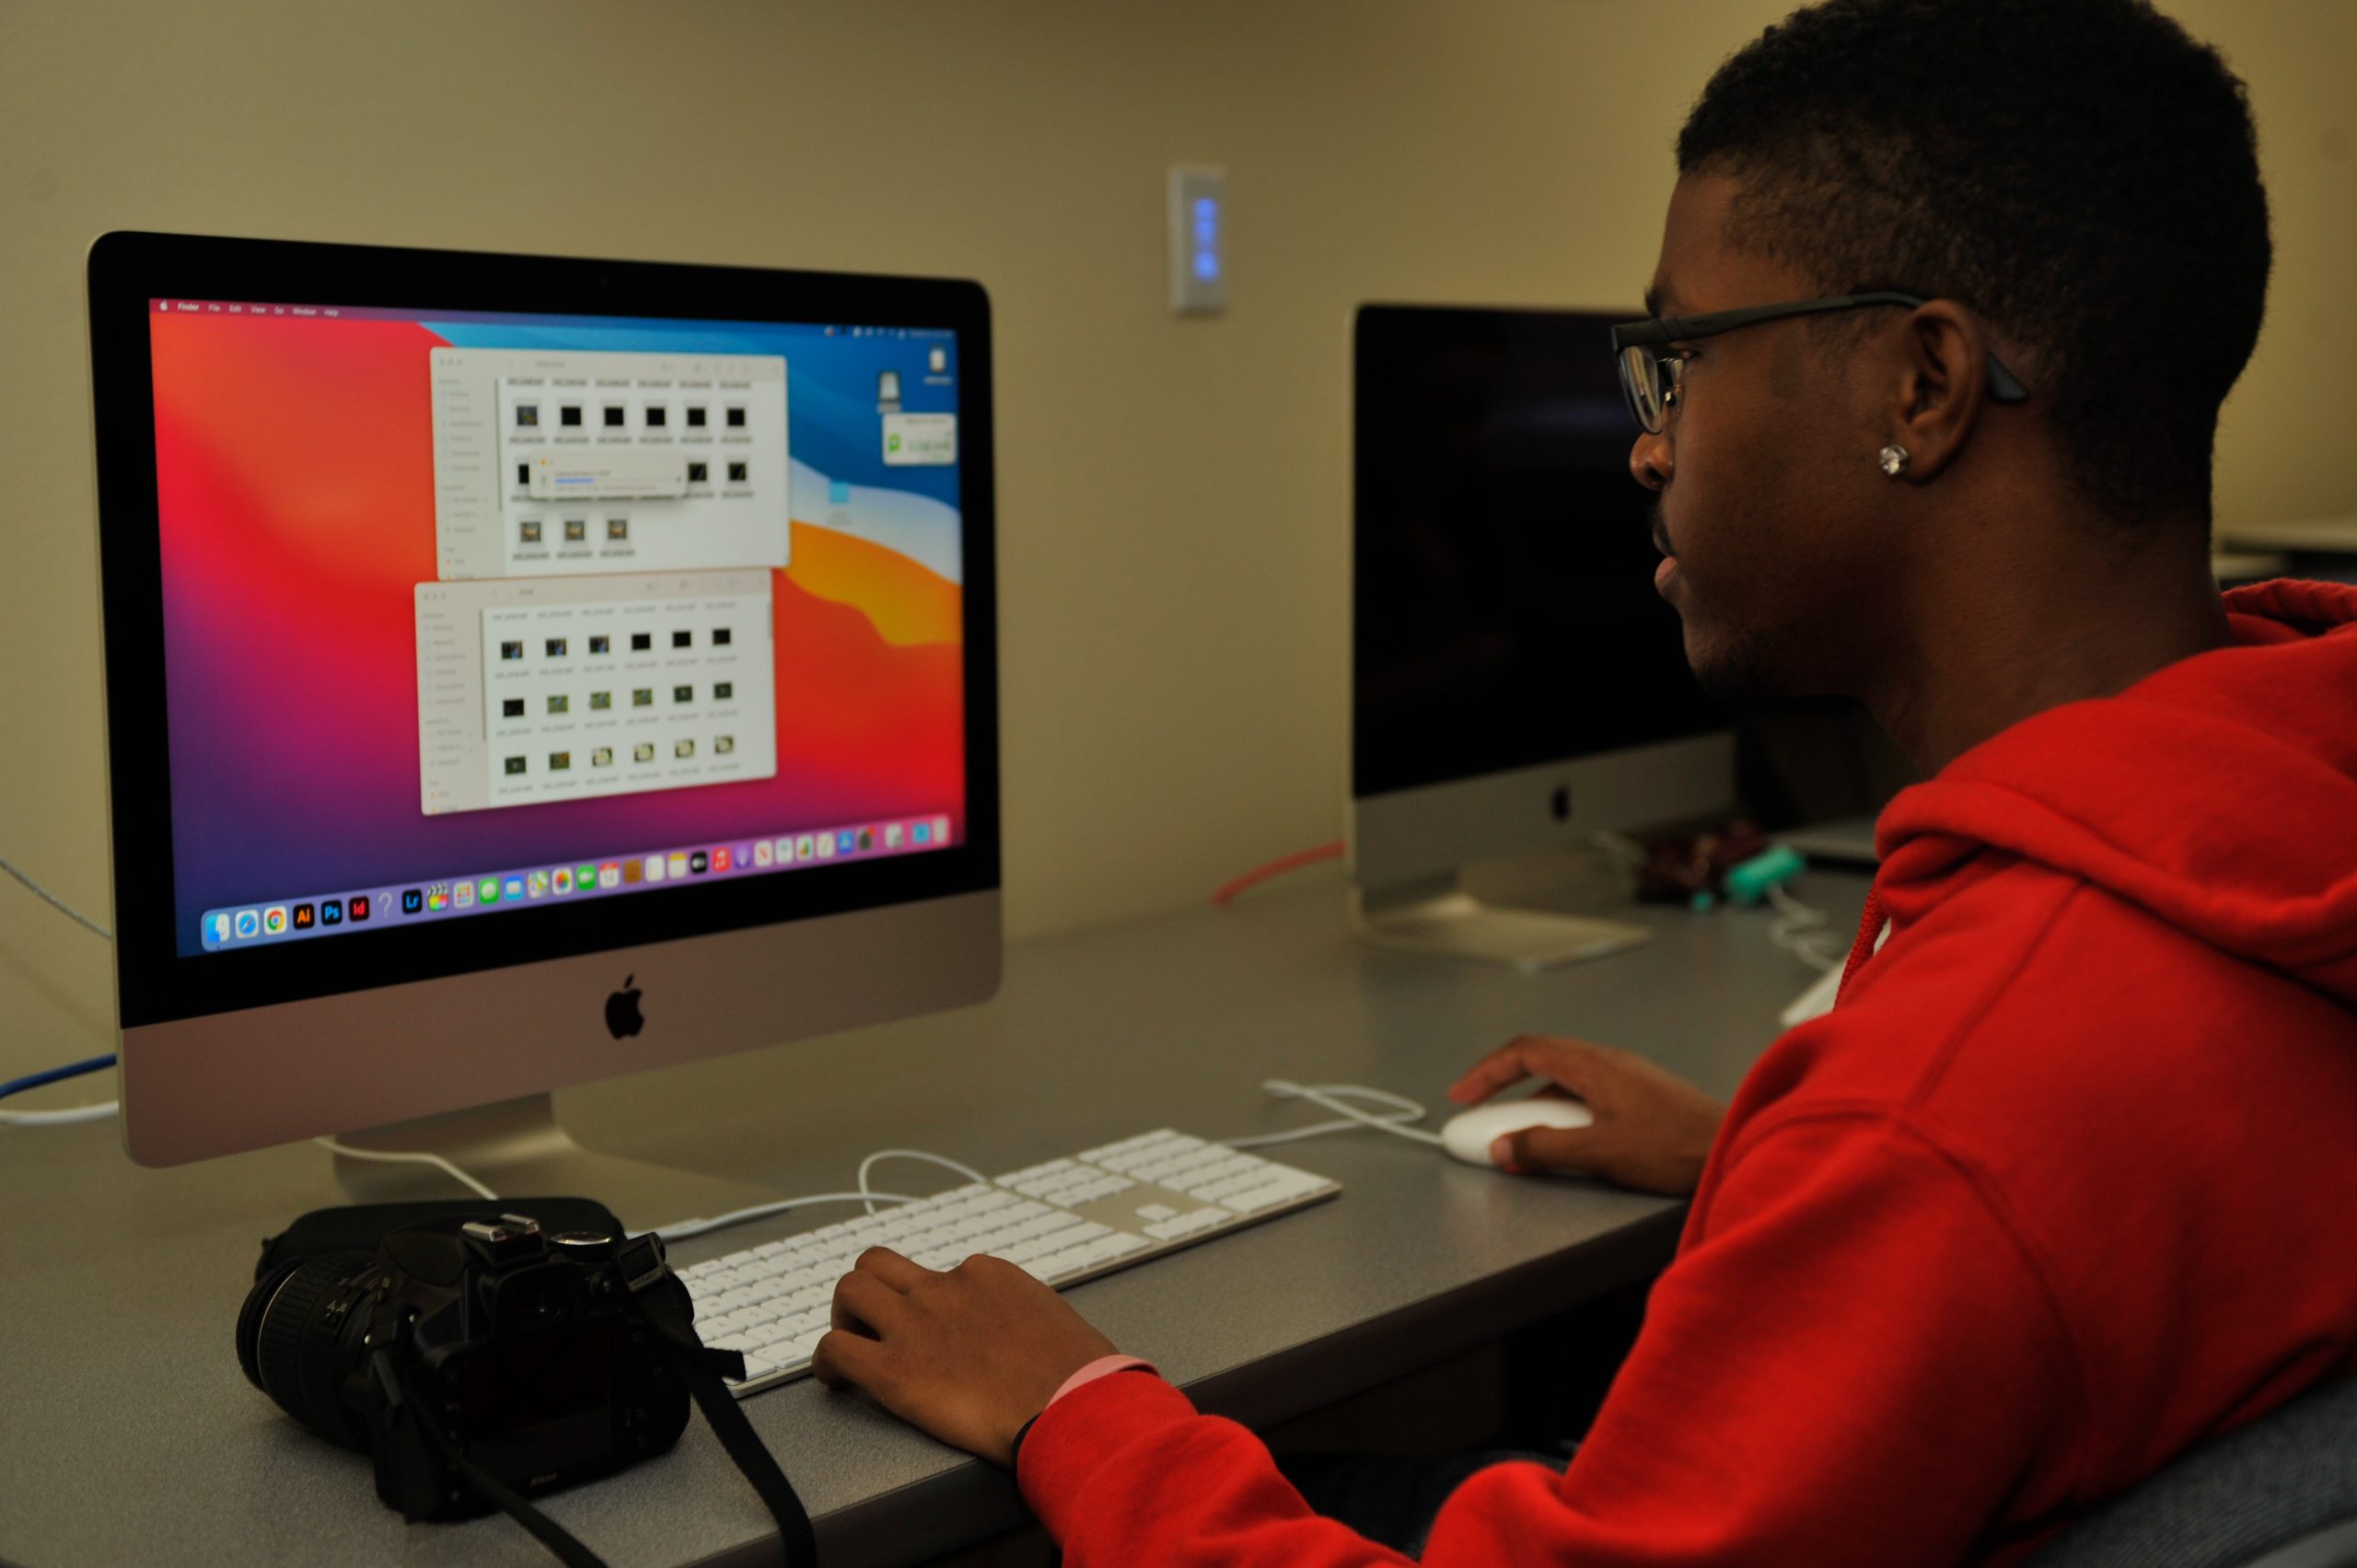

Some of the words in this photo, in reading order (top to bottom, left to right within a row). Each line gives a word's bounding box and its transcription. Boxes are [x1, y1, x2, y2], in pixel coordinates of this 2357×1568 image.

[178, 302, 200, 311] Finder
[208, 303, 221, 312] File
[229, 304, 242, 313] Edit
[250, 305, 266, 314] View
[273, 306, 284, 315] Go
[292, 307, 317, 316] Window
[353, 900, 366, 916] Id
[405, 896, 419, 910] Lr
[296, 908, 311, 923] Ai
[324, 905, 340, 920] Ps
